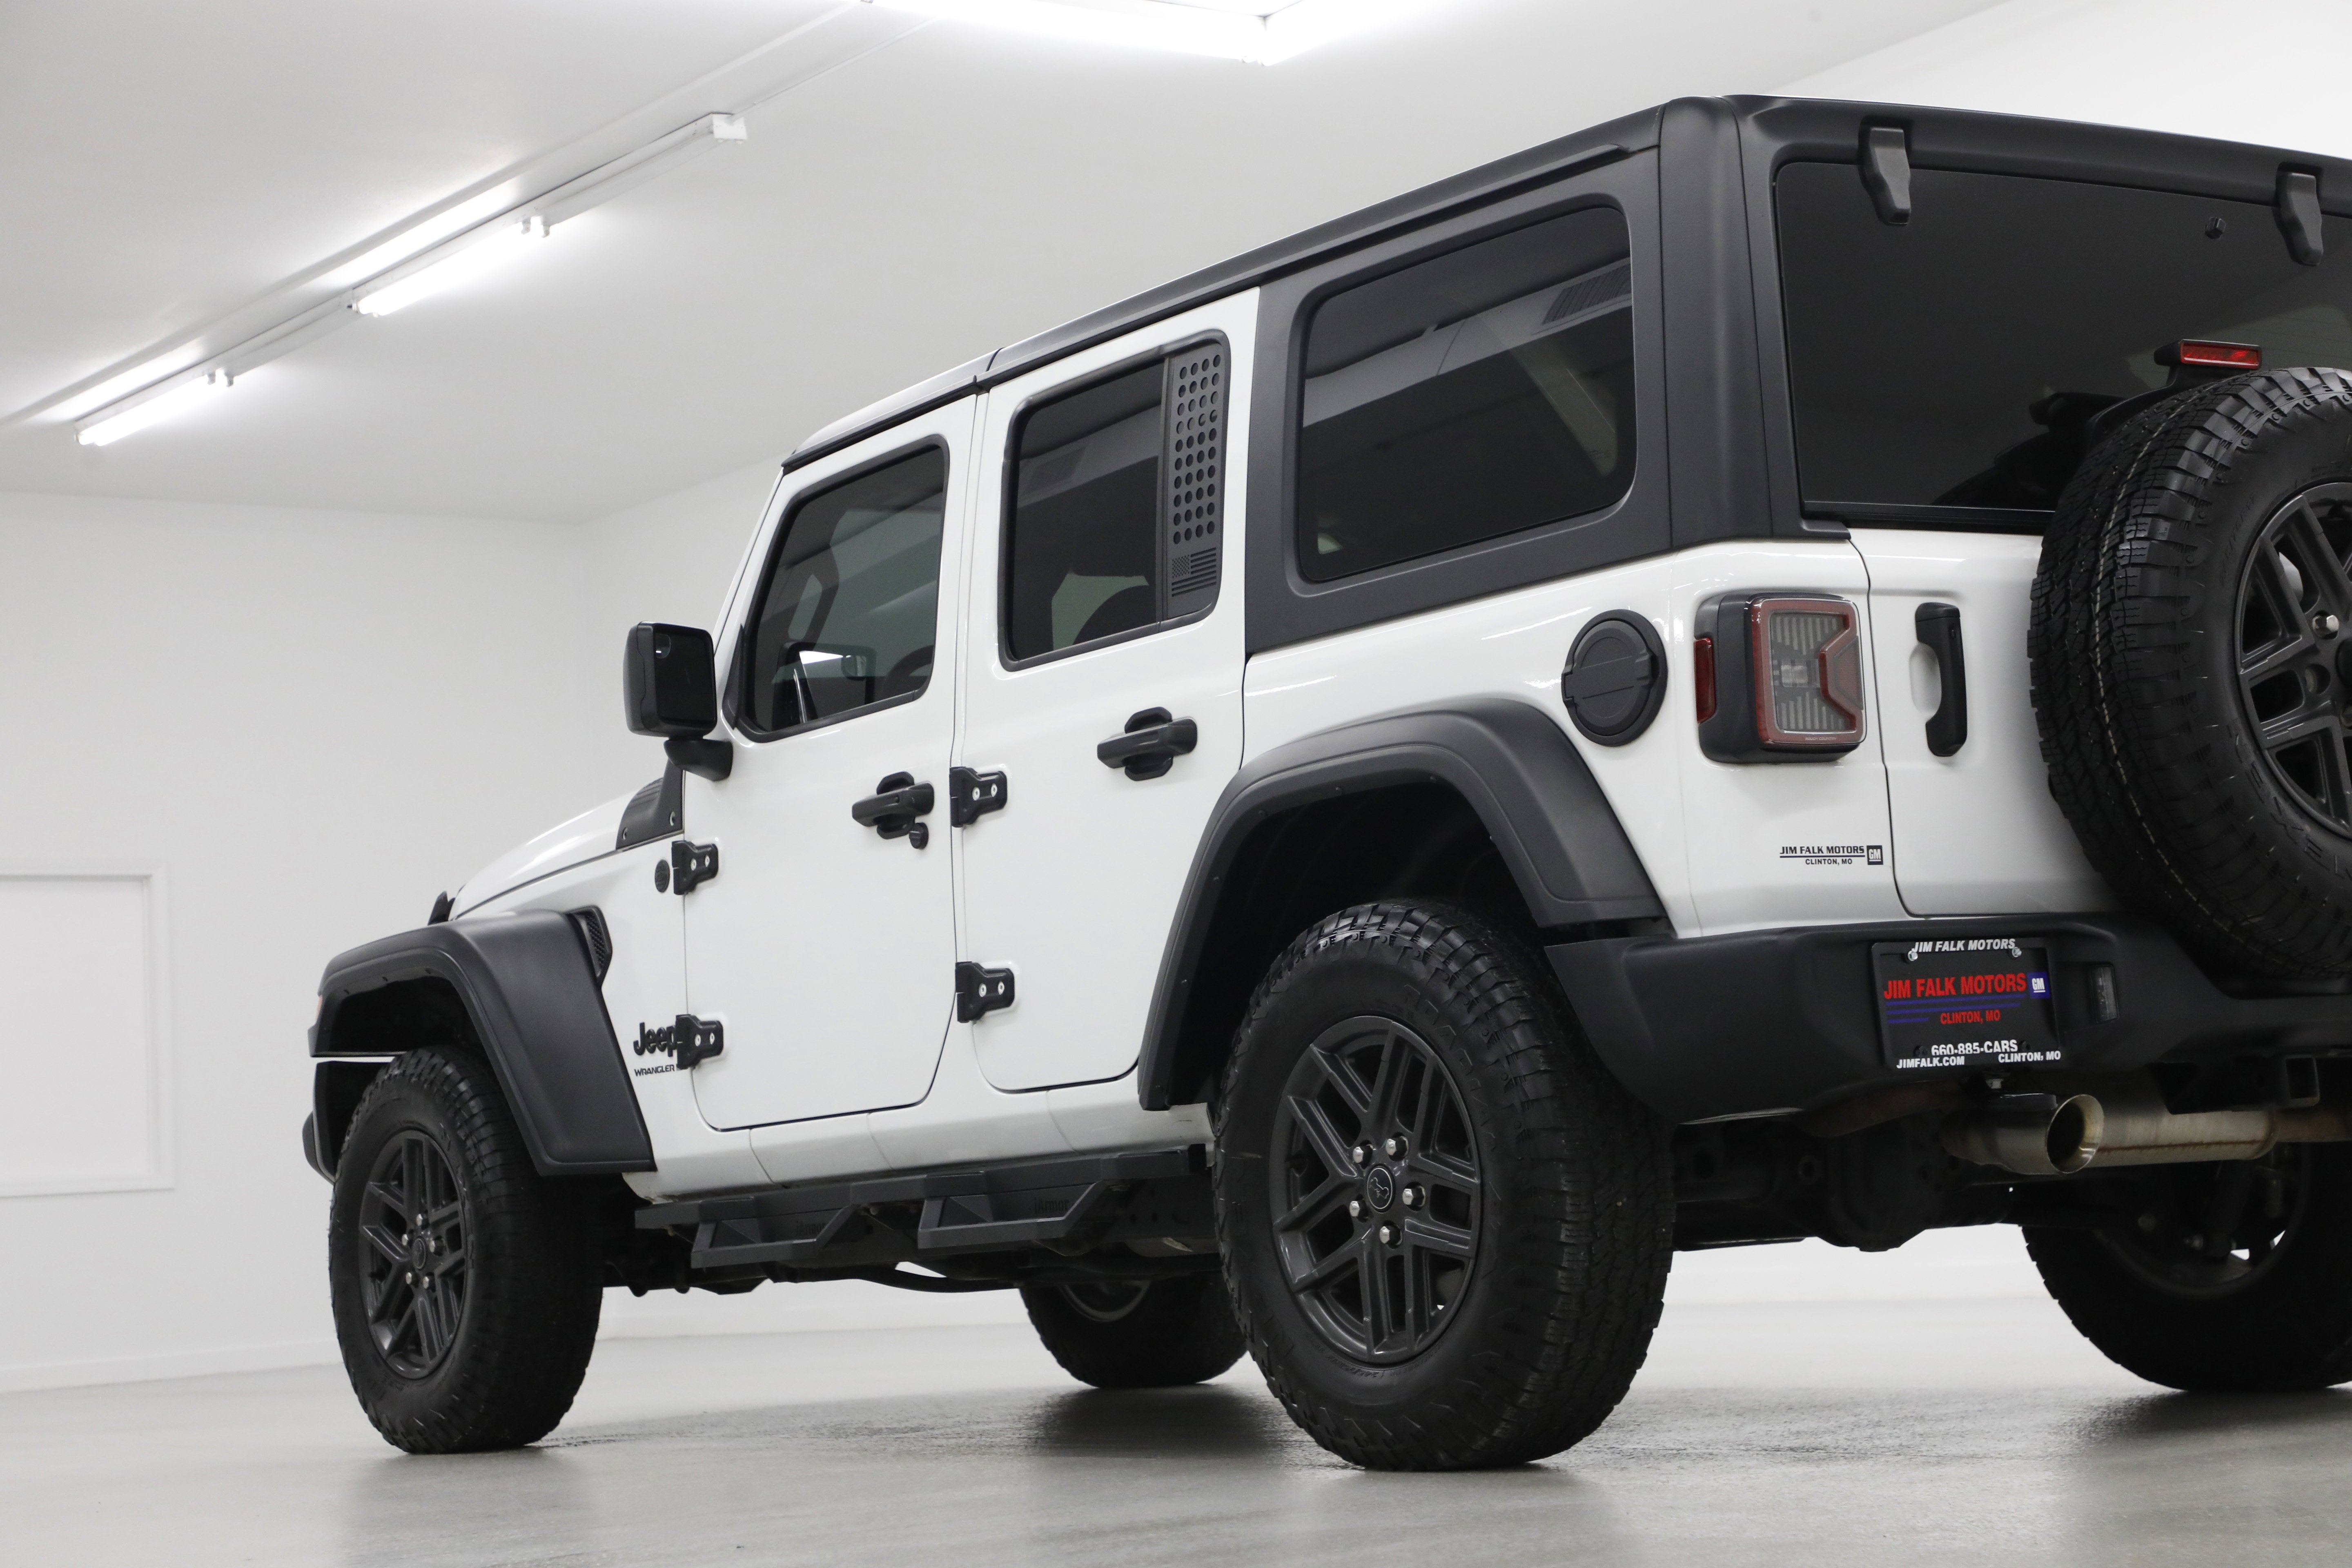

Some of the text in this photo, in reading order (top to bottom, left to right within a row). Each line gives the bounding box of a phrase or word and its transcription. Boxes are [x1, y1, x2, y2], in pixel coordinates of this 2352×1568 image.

[1800, 846, 1824, 854] FALK
[1826, 846, 1864, 854] MOTORS
[1869, 849, 1881, 860] GM
[1911, 938, 2016, 952] JIM FALK MOTORS
[1884, 973, 2027, 999] JIM FALK MOTORS
[2032, 978, 2045, 991] GM
[1940, 1010, 2000, 1024] CLINTON, MO
[633, 1022, 678, 1057] Jeep
[1931, 1039, 2018, 1056] 660-885-CARS
[1896, 1056, 1965, 1069] JIMFALK.COM
[1998, 1051, 2061, 1063] CLINTON, MO
[634, 1064, 675, 1077] WRANGLER
[1034, 1197, 1069, 1214] iArmor
